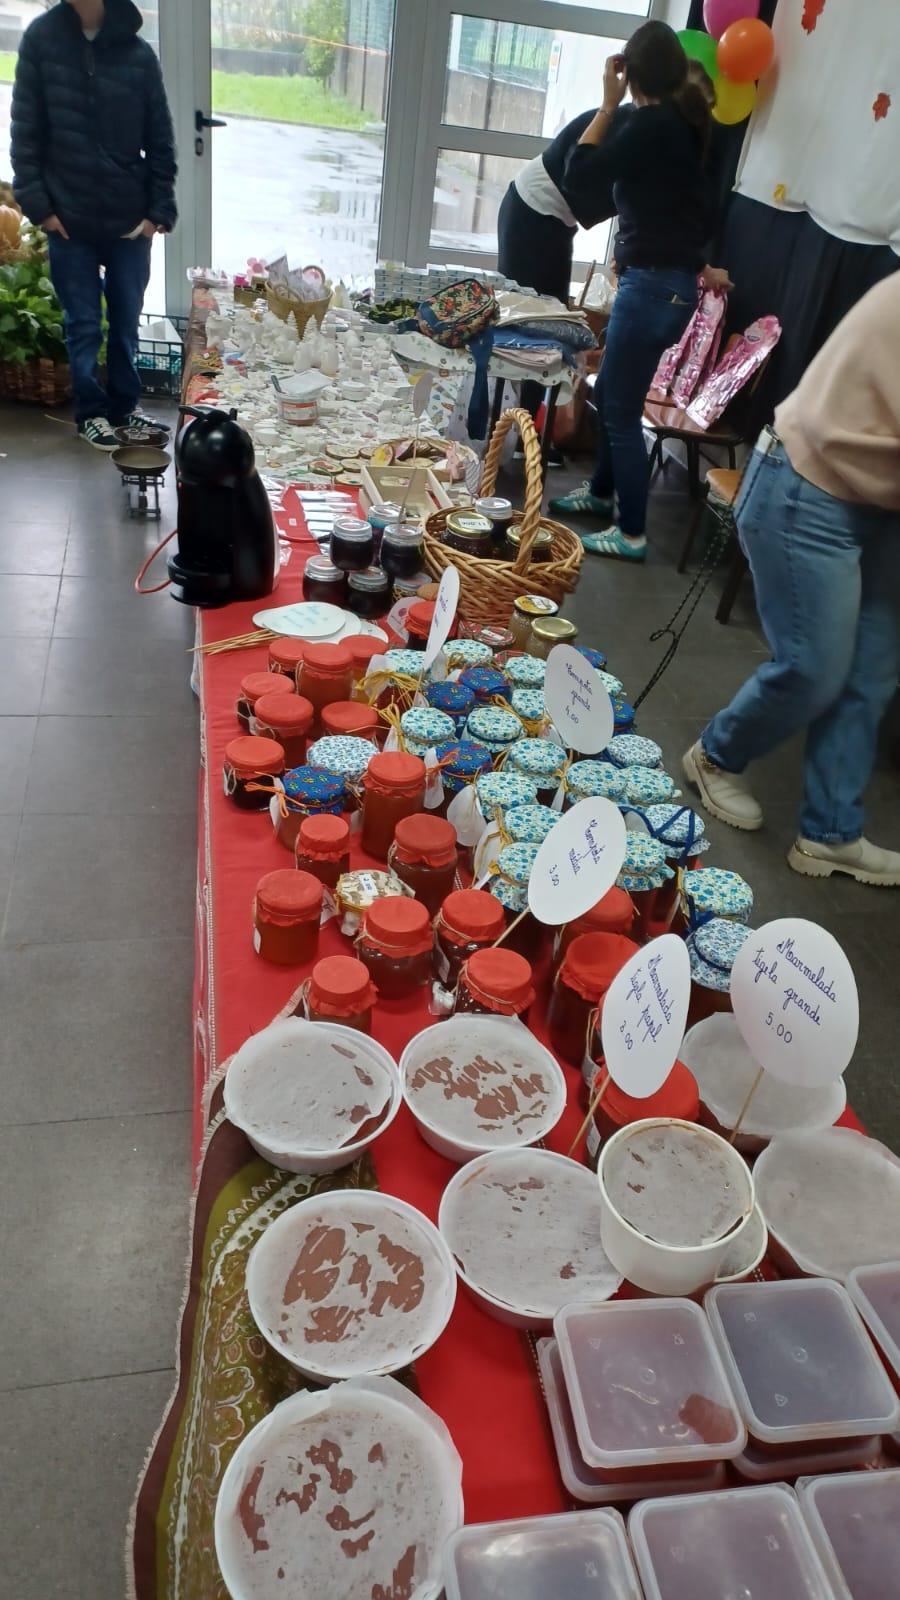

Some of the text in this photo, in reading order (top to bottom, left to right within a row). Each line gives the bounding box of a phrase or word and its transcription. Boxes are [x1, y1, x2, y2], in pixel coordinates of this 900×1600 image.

[626, 967, 663, 1043] tigela papel
[647, 954, 675, 1025] Marmelada
[752, 947, 821, 1026] tigela grande
[776, 938, 837, 1003] Marmelada
[765, 1011, 793, 1044] 5.00
